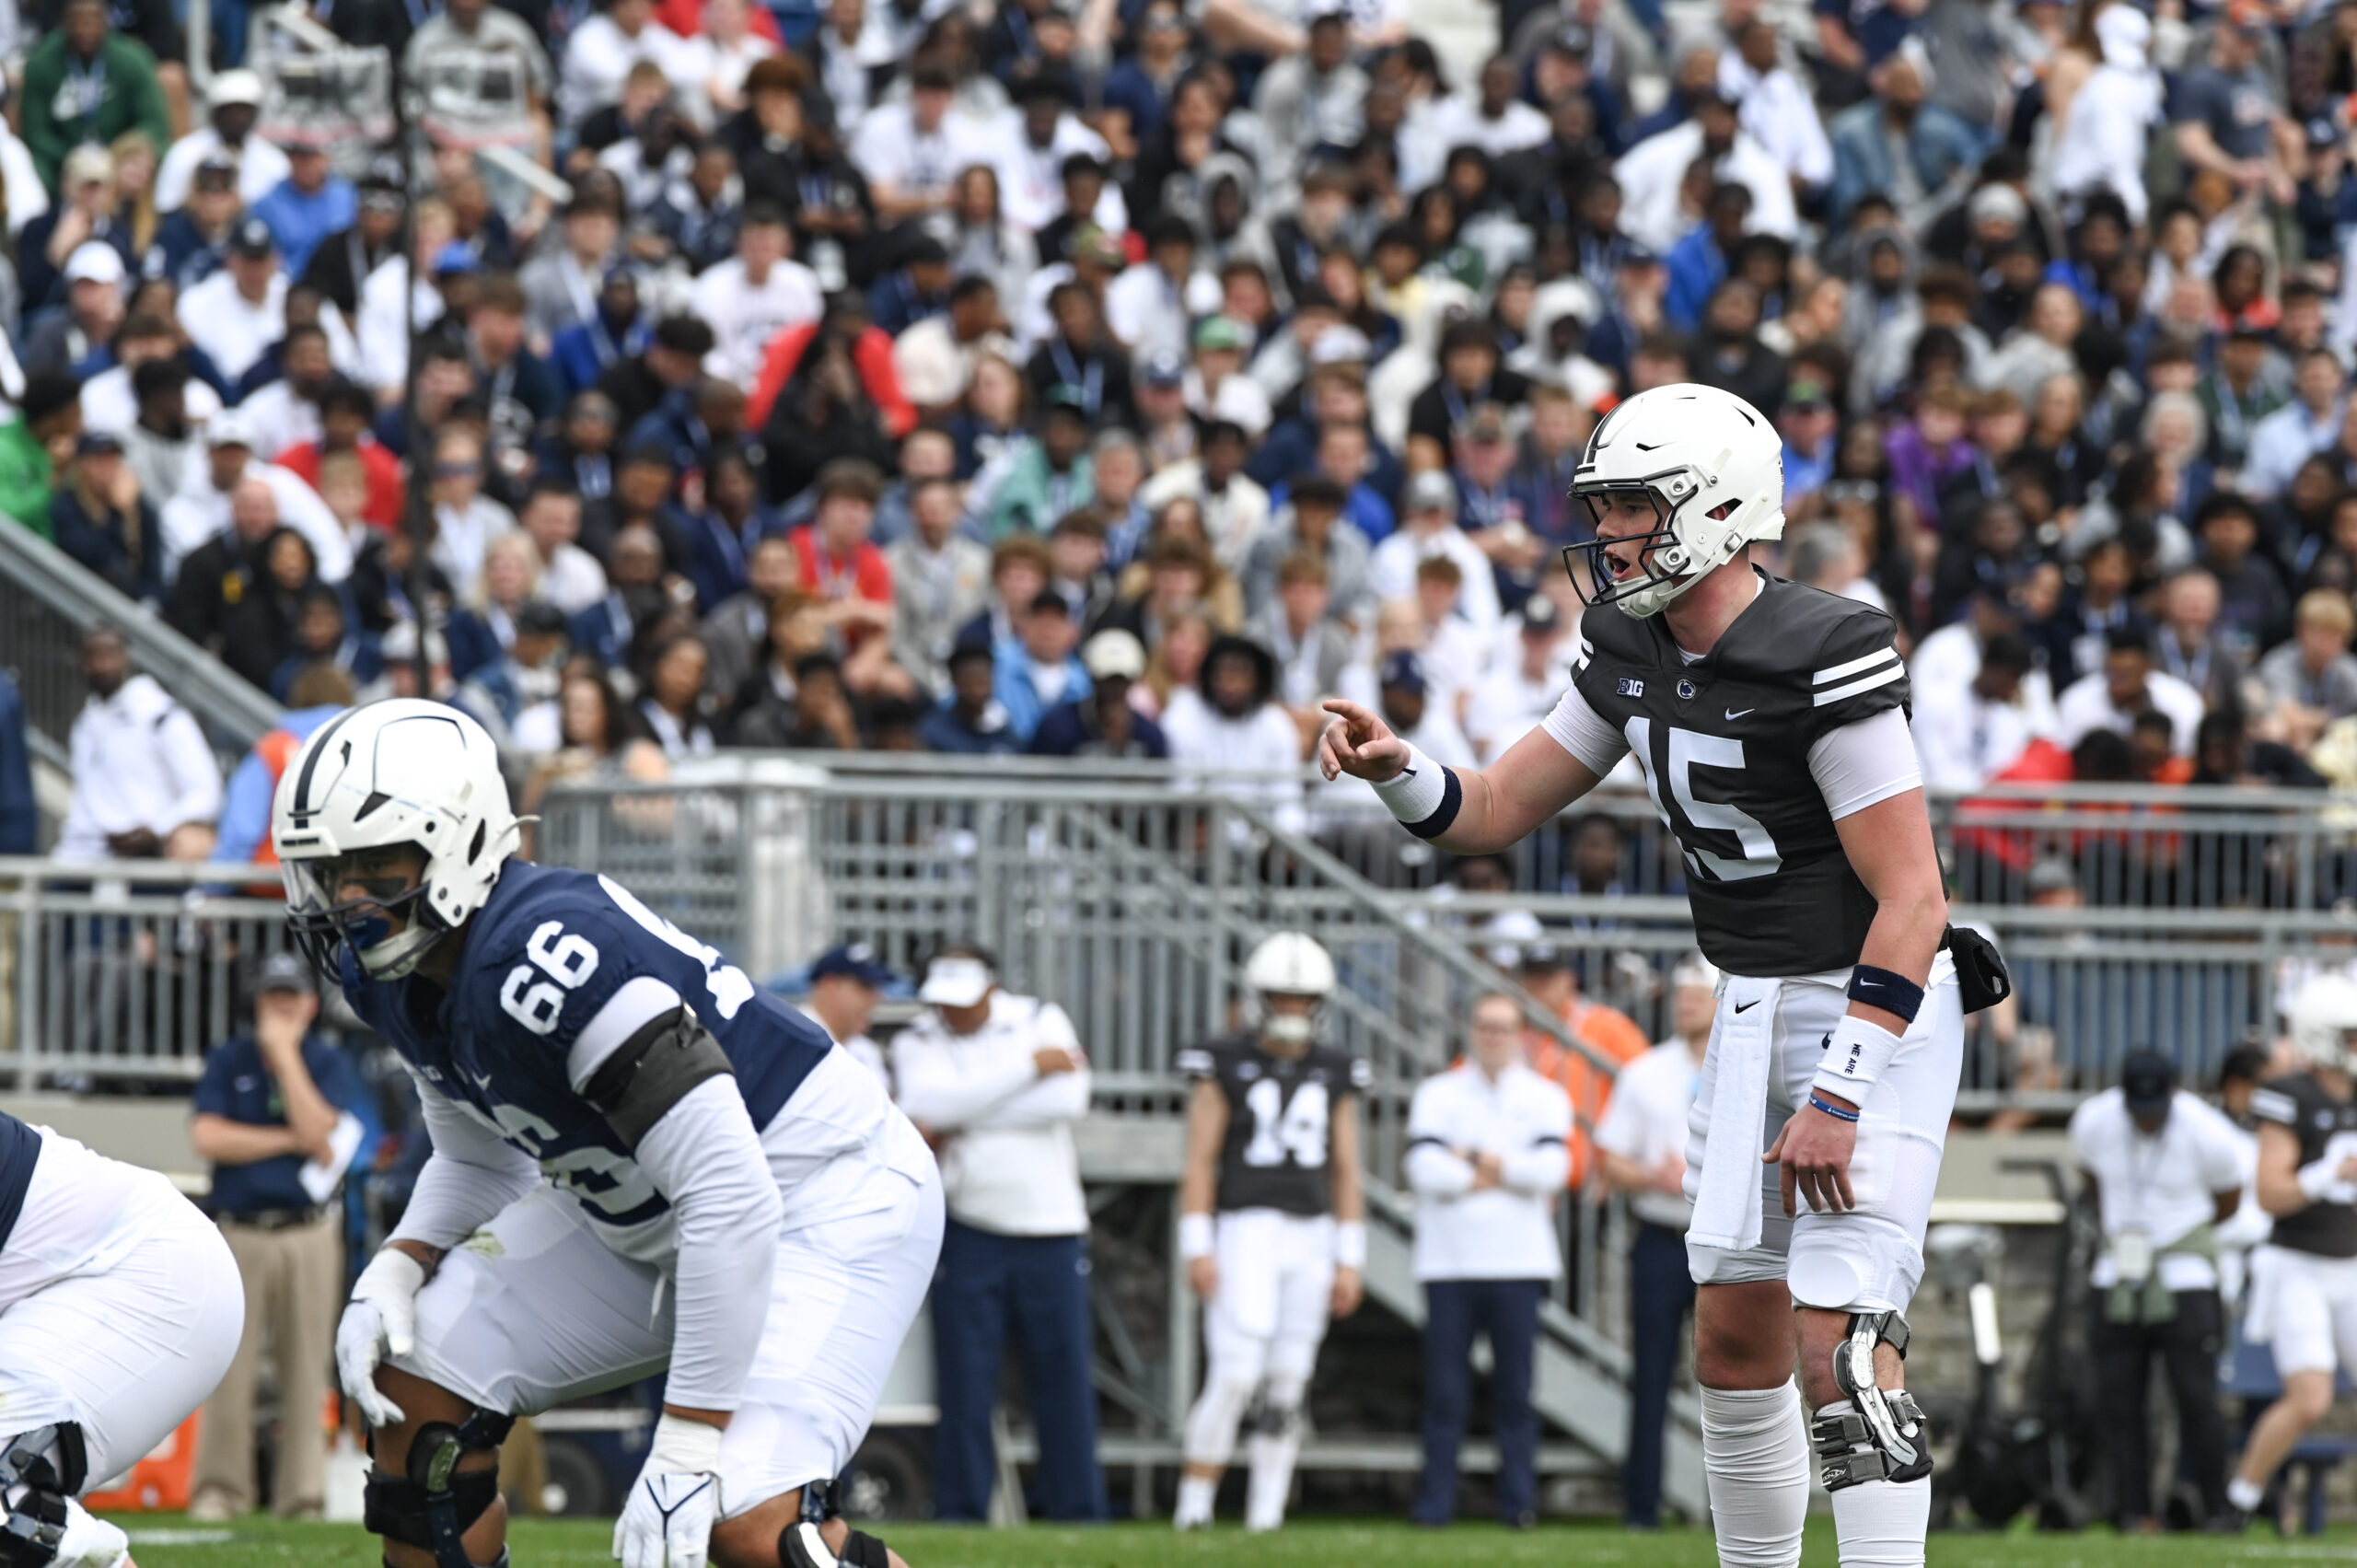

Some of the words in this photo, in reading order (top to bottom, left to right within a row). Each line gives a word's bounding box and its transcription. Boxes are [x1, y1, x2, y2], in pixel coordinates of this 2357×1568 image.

[1625, 715, 1783, 881] 15
[500, 920, 598, 1036] 66
[1844, 1058, 1857, 1074] ARE
[1852, 1043, 1862, 1057] WE
[1244, 1077, 1328, 1168] 14
